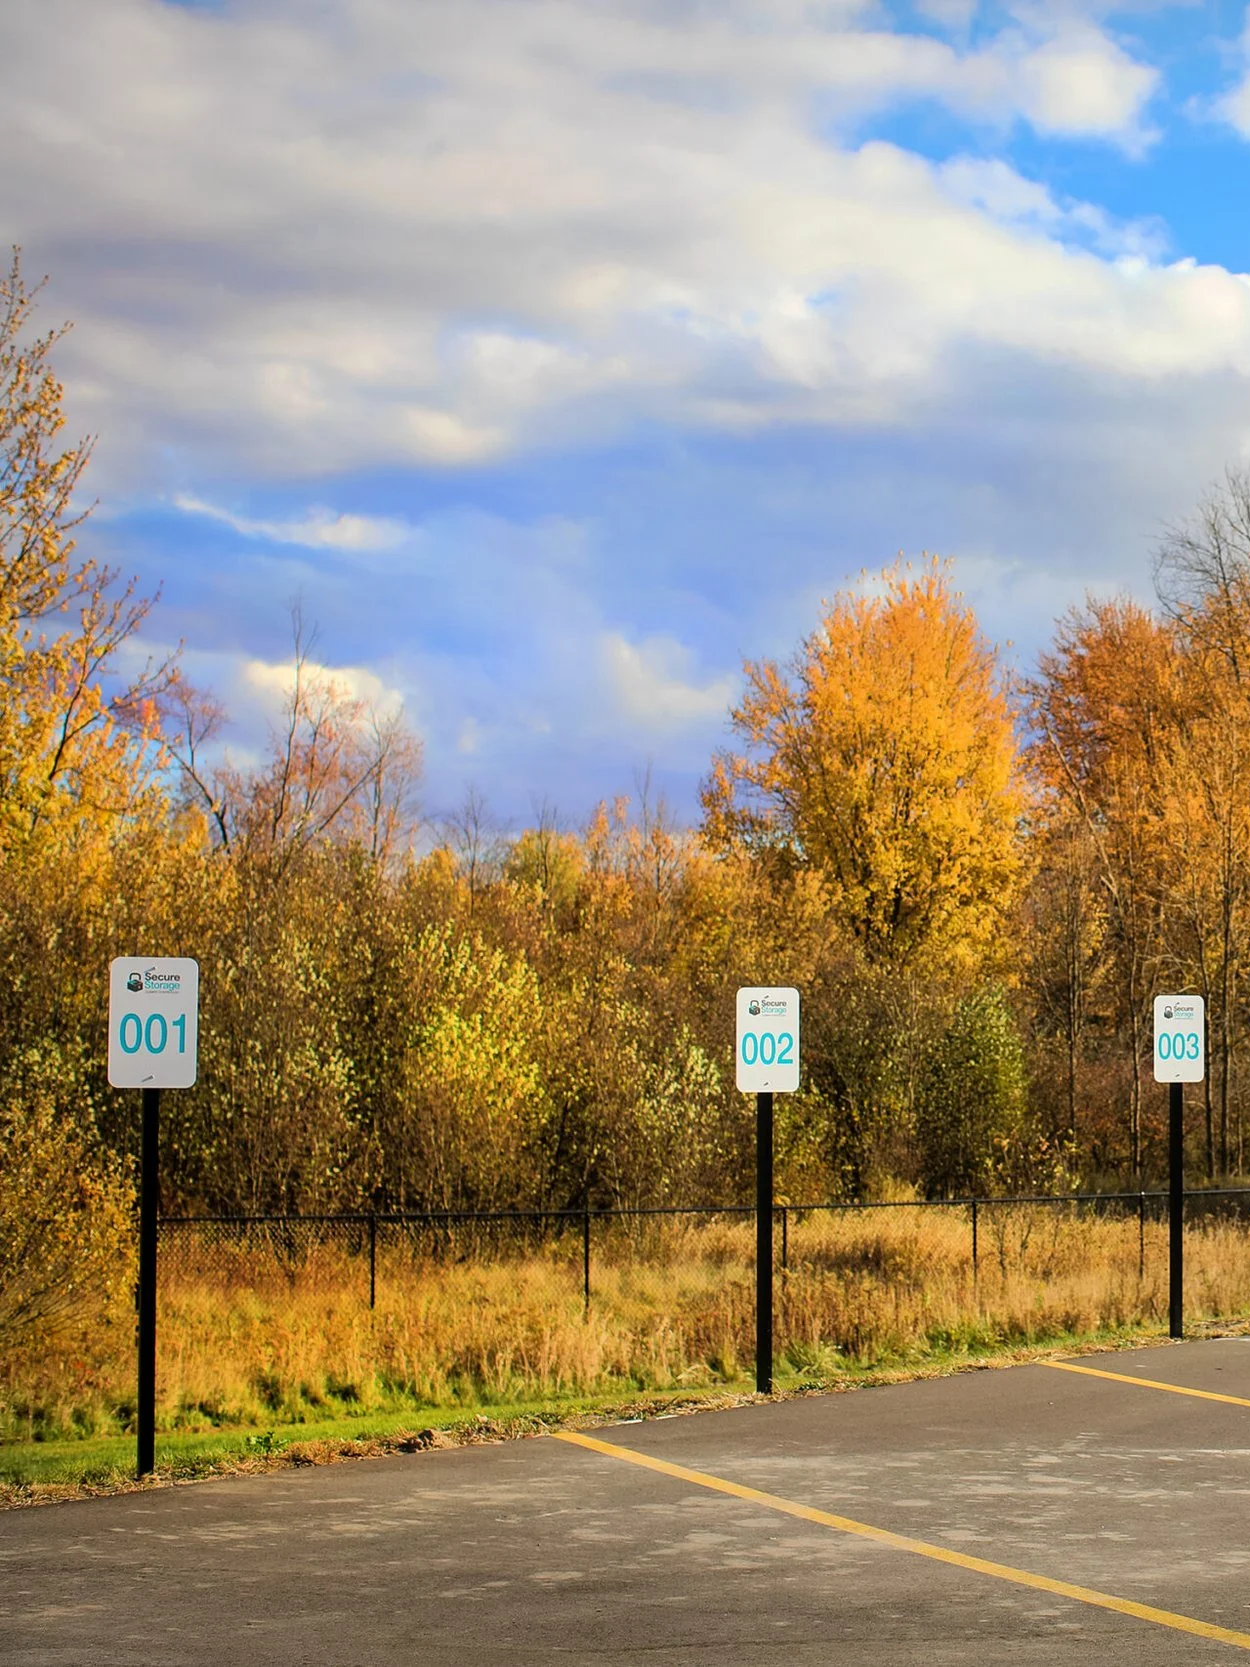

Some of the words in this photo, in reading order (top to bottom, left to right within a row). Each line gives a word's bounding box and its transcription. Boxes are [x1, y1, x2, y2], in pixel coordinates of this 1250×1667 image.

[144, 971, 181, 982] Secure
[144, 981, 181, 991] Storage
[761, 999, 787, 1007] Secure
[761, 1007, 787, 1015] Storage
[119, 1012, 187, 1055] 001
[741, 1032, 794, 1065] 002
[1158, 1032, 1200, 1060] 003
